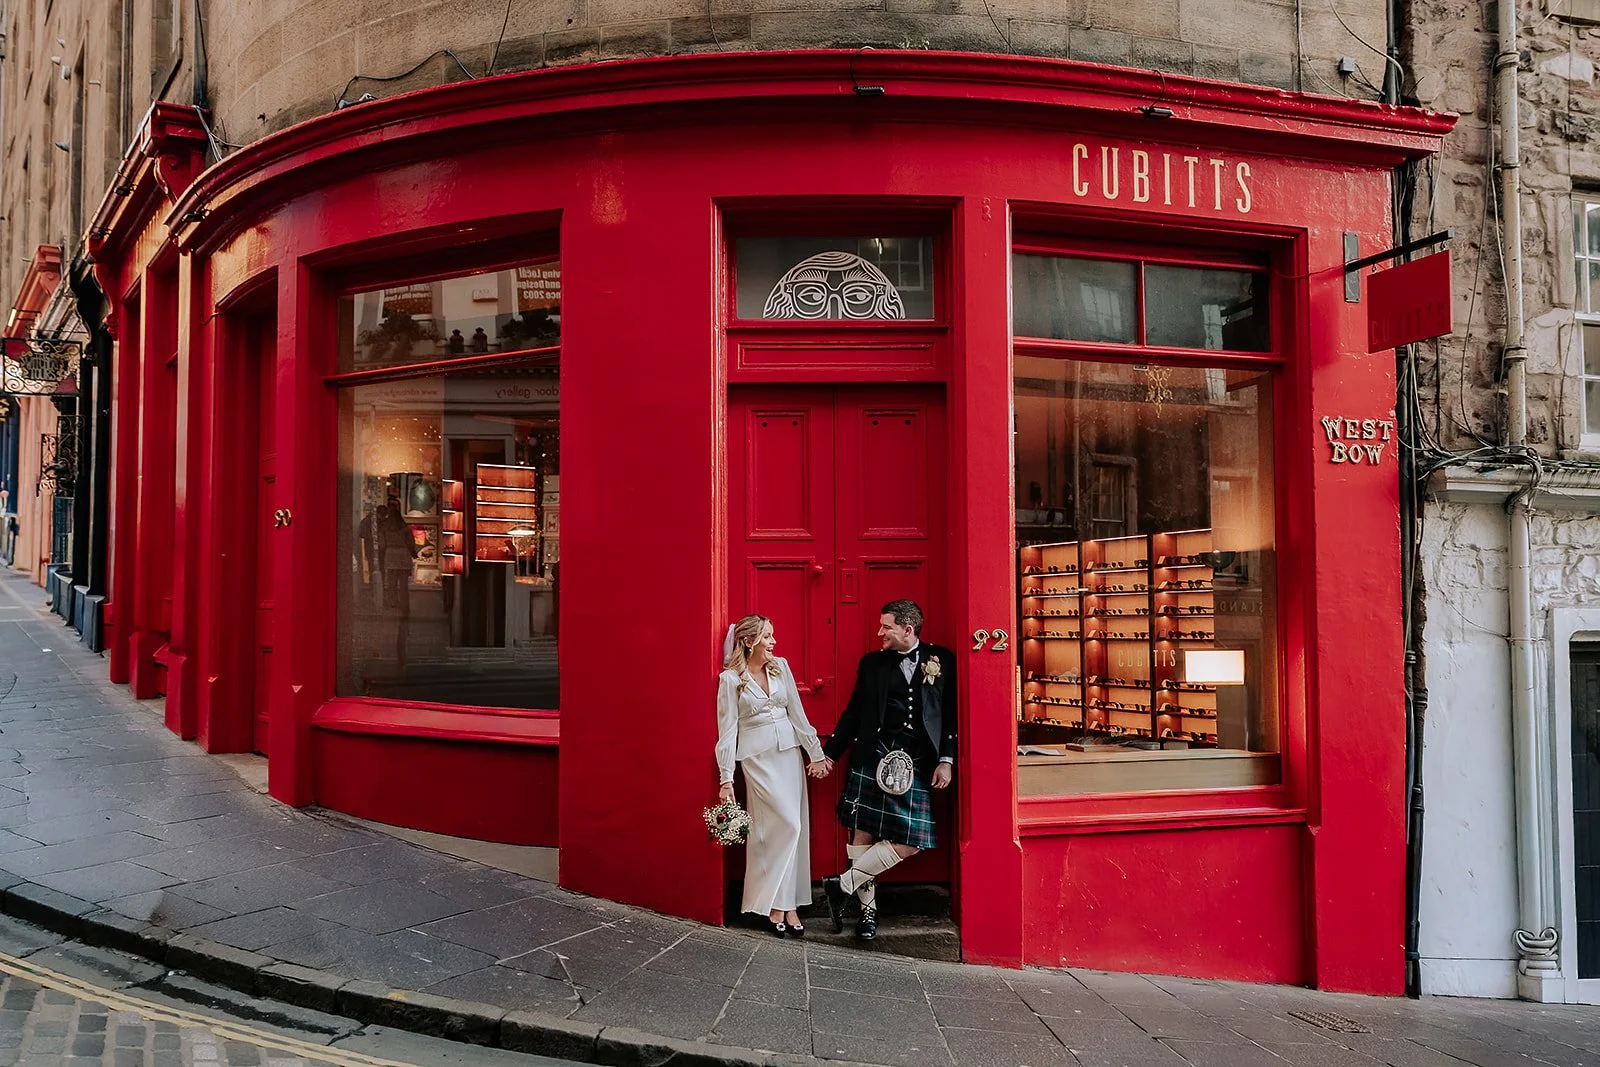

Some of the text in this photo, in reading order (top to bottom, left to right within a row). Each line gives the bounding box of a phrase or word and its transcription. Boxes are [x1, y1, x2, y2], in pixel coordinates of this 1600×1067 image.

[1072, 143, 1252, 214] CUBITTS
[1320, 415, 1394, 441] WEST
[1329, 440, 1386, 465] BOW
[972, 628, 1009, 652] 92
